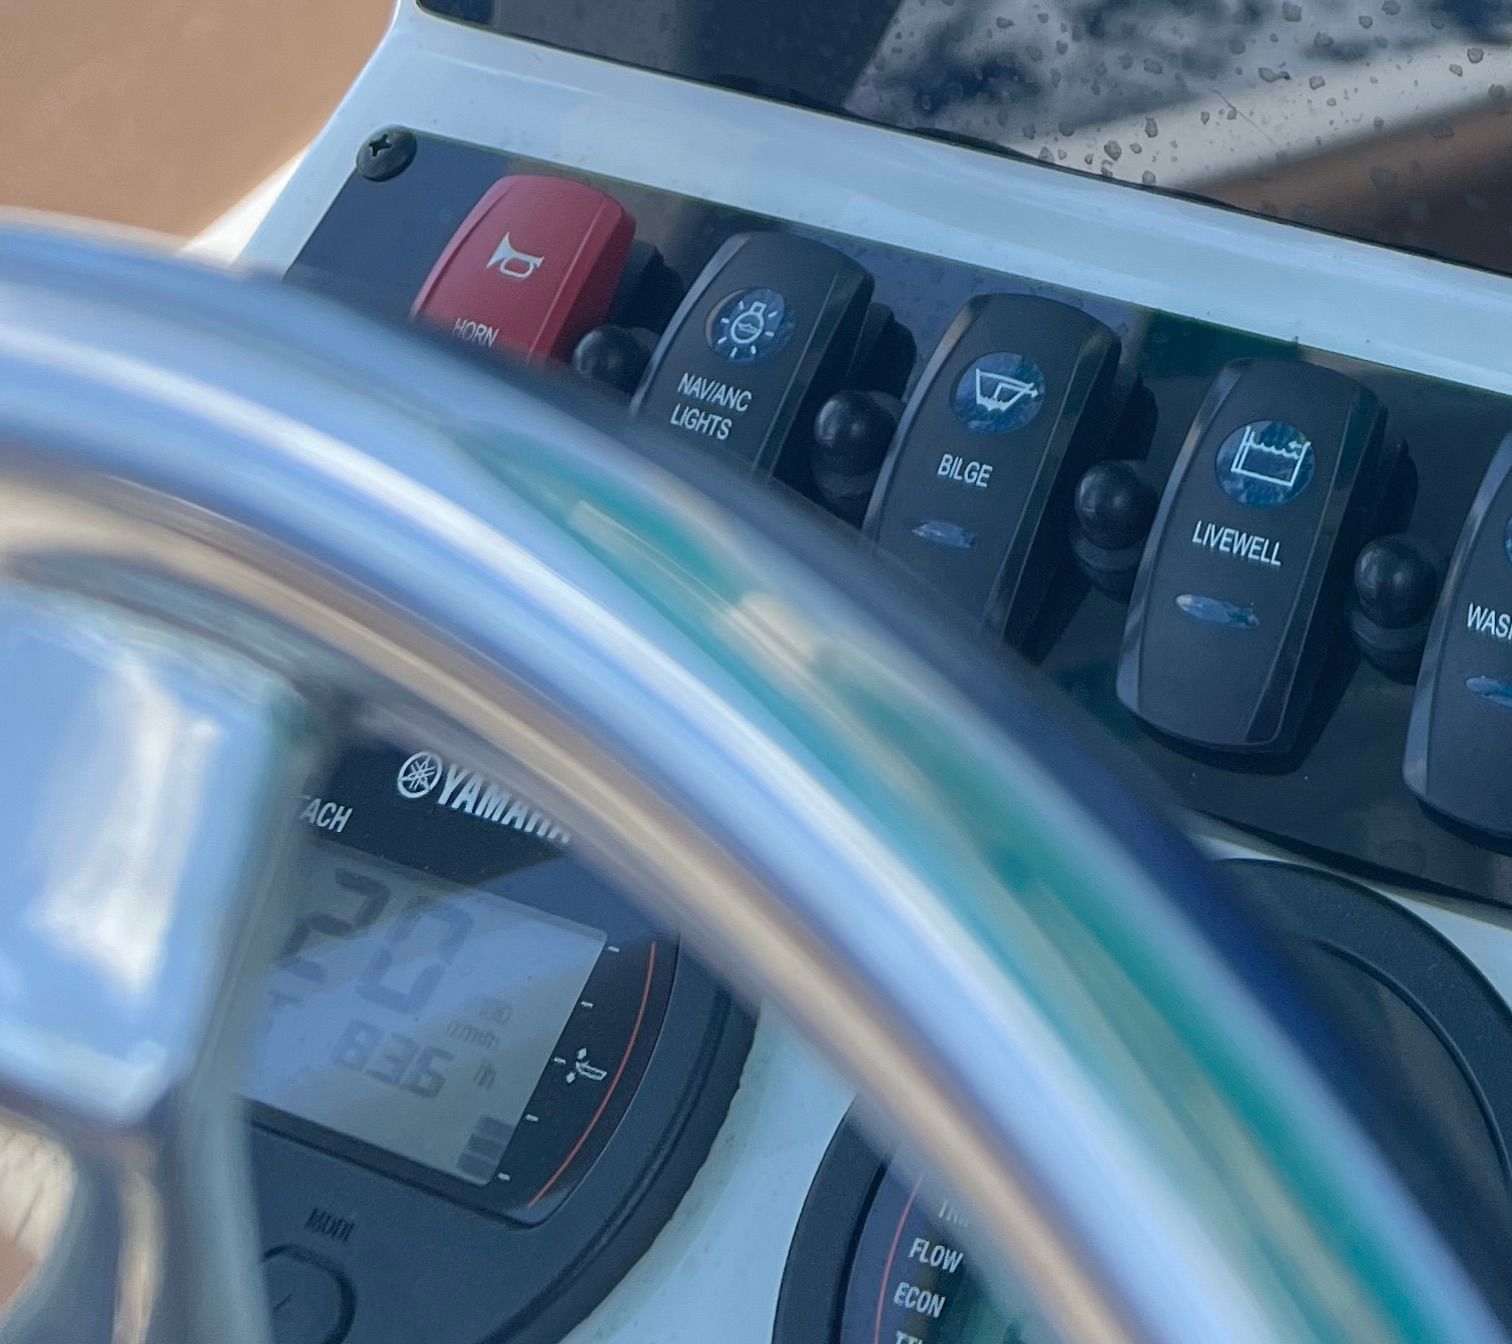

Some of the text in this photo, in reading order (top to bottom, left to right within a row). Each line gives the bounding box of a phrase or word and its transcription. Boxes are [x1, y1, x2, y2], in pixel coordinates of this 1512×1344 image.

[453, 317, 501, 348] HORN
[670, 403, 732, 441] LIGHTS
[937, 453, 993, 489] BILGE
[1191, 520, 1282, 567] LIVEWELL
[301, 796, 353, 834] ACH
[332, 1018, 454, 1099] 836
[908, 1237, 965, 1274] FLOW
[892, 1281, 947, 1319] ECON
